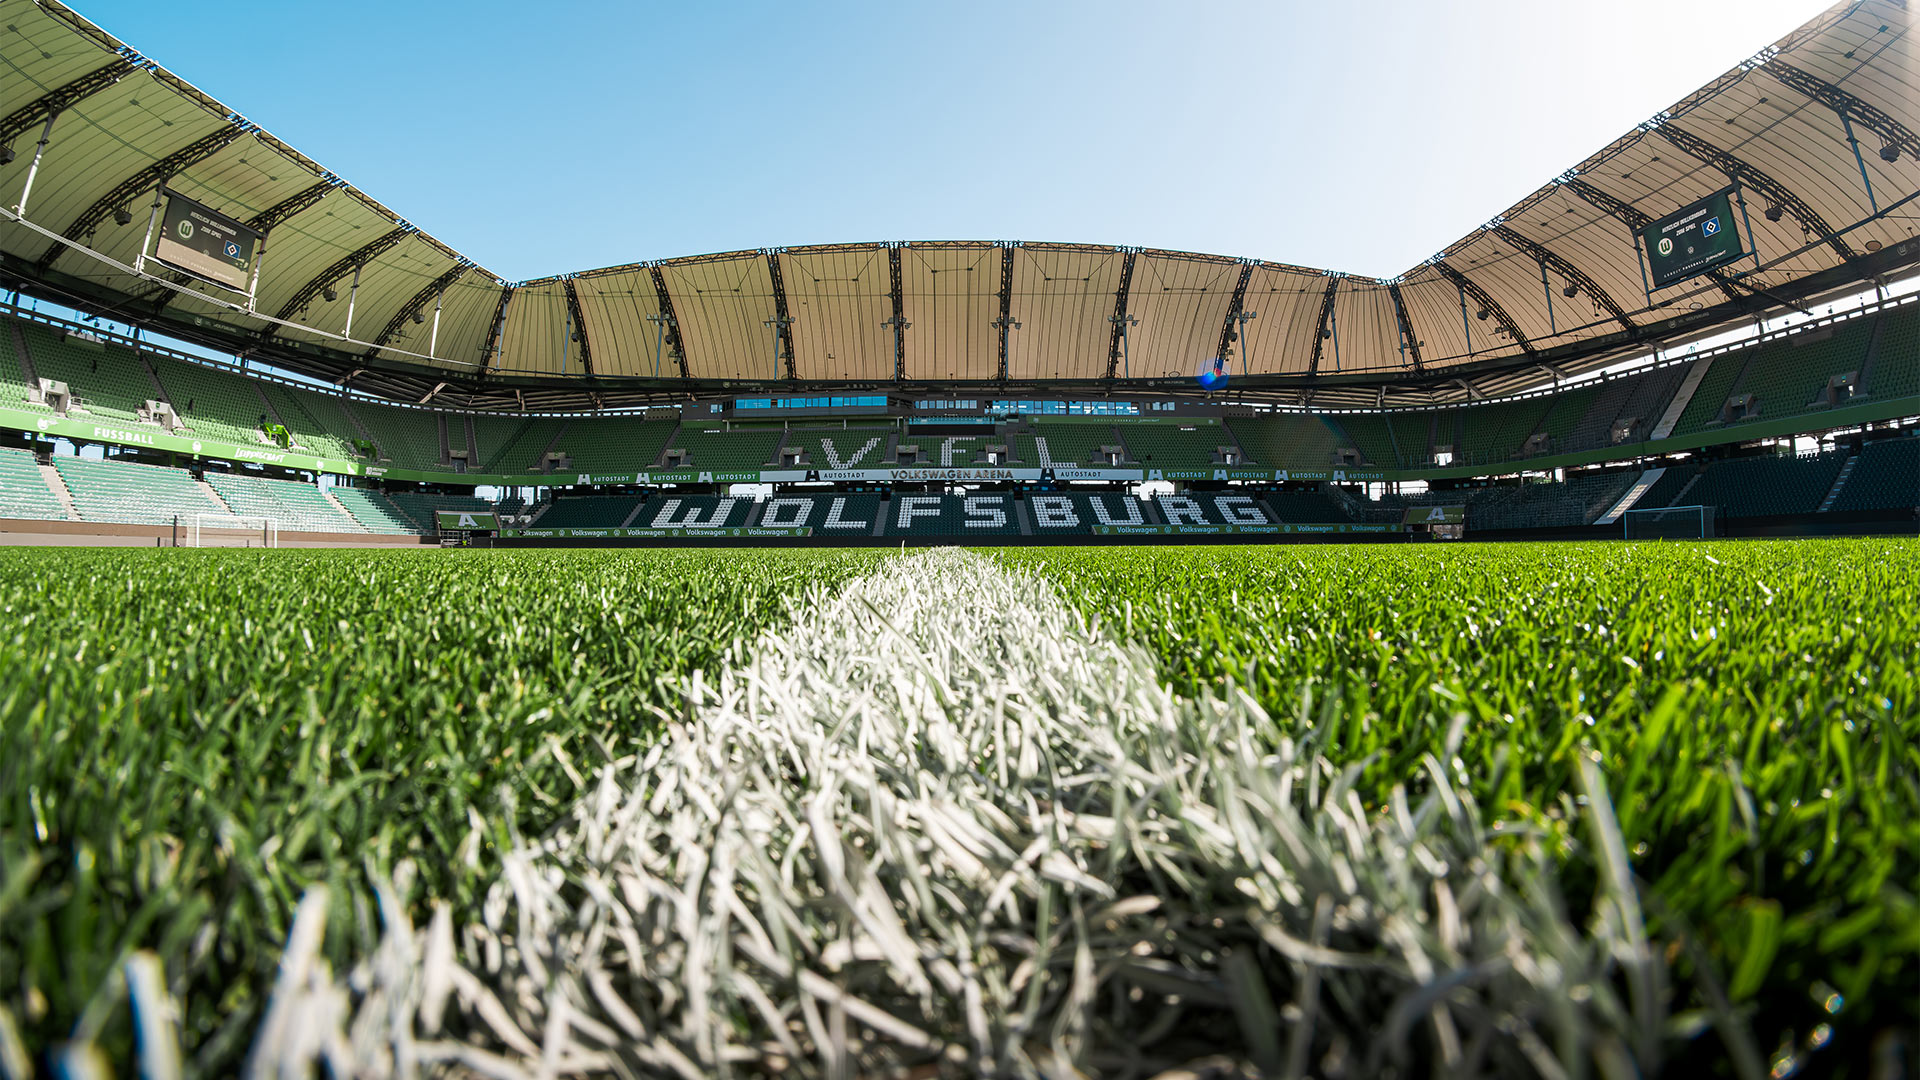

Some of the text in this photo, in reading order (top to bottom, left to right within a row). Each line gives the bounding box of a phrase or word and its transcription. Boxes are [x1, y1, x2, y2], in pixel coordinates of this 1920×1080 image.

[94, 427, 154, 445] FUSSBALL
[891, 469, 1013, 480] VOLKSWAGEN ARENA
[651, 495, 1269, 528] WOLFSBURG
[571, 529, 607, 537] Volkswagen
[627, 529, 665, 537] Volkswagen
[686, 528, 726, 537] Volkswagen
[748, 528, 789, 536] Volkswagen
[1117, 526, 1158, 534] Volkswagen
[1179, 526, 1219, 534] Volkswagen
[1239, 525, 1279, 533] Volkswagen
[1298, 525, 1333, 533] Volkswagen
